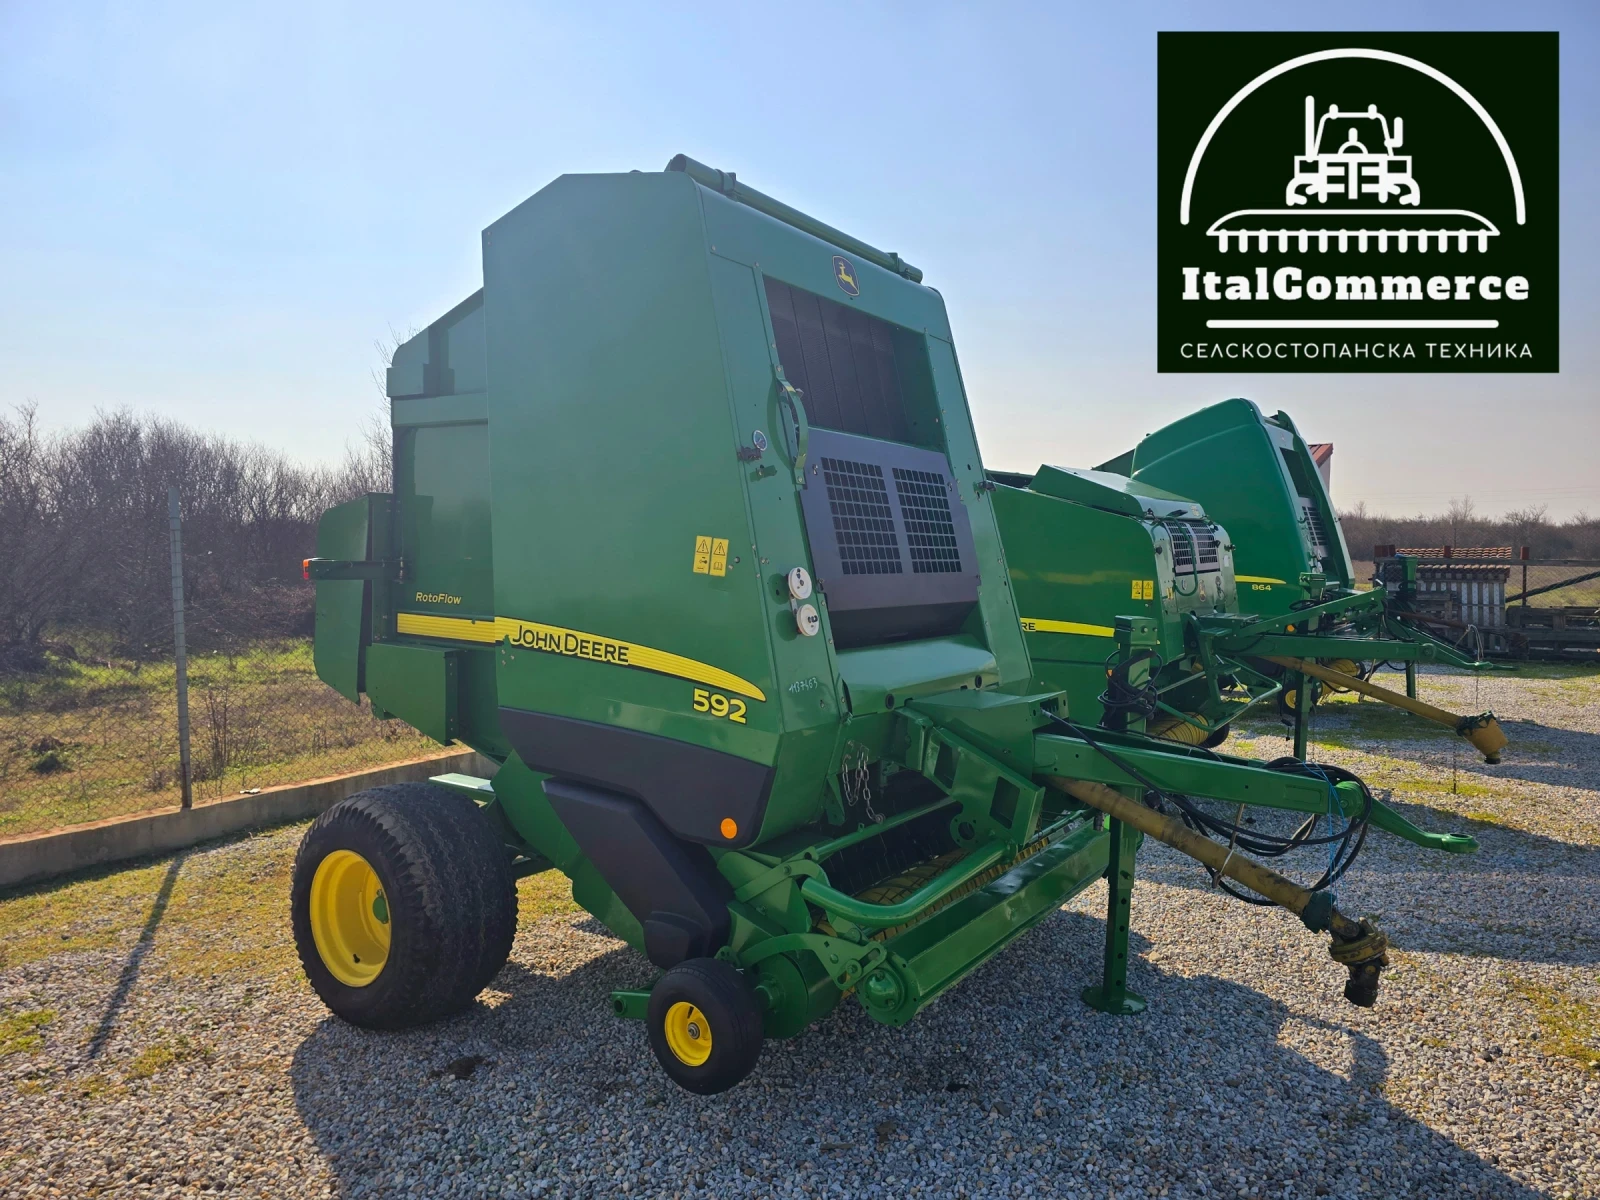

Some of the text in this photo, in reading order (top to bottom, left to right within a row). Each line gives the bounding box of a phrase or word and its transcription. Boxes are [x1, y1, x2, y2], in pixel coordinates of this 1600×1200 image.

[415, 591, 462, 605] RotoFlow
[512, 625, 630, 663] JOHN DEERE
[692, 687, 747, 724] 592
